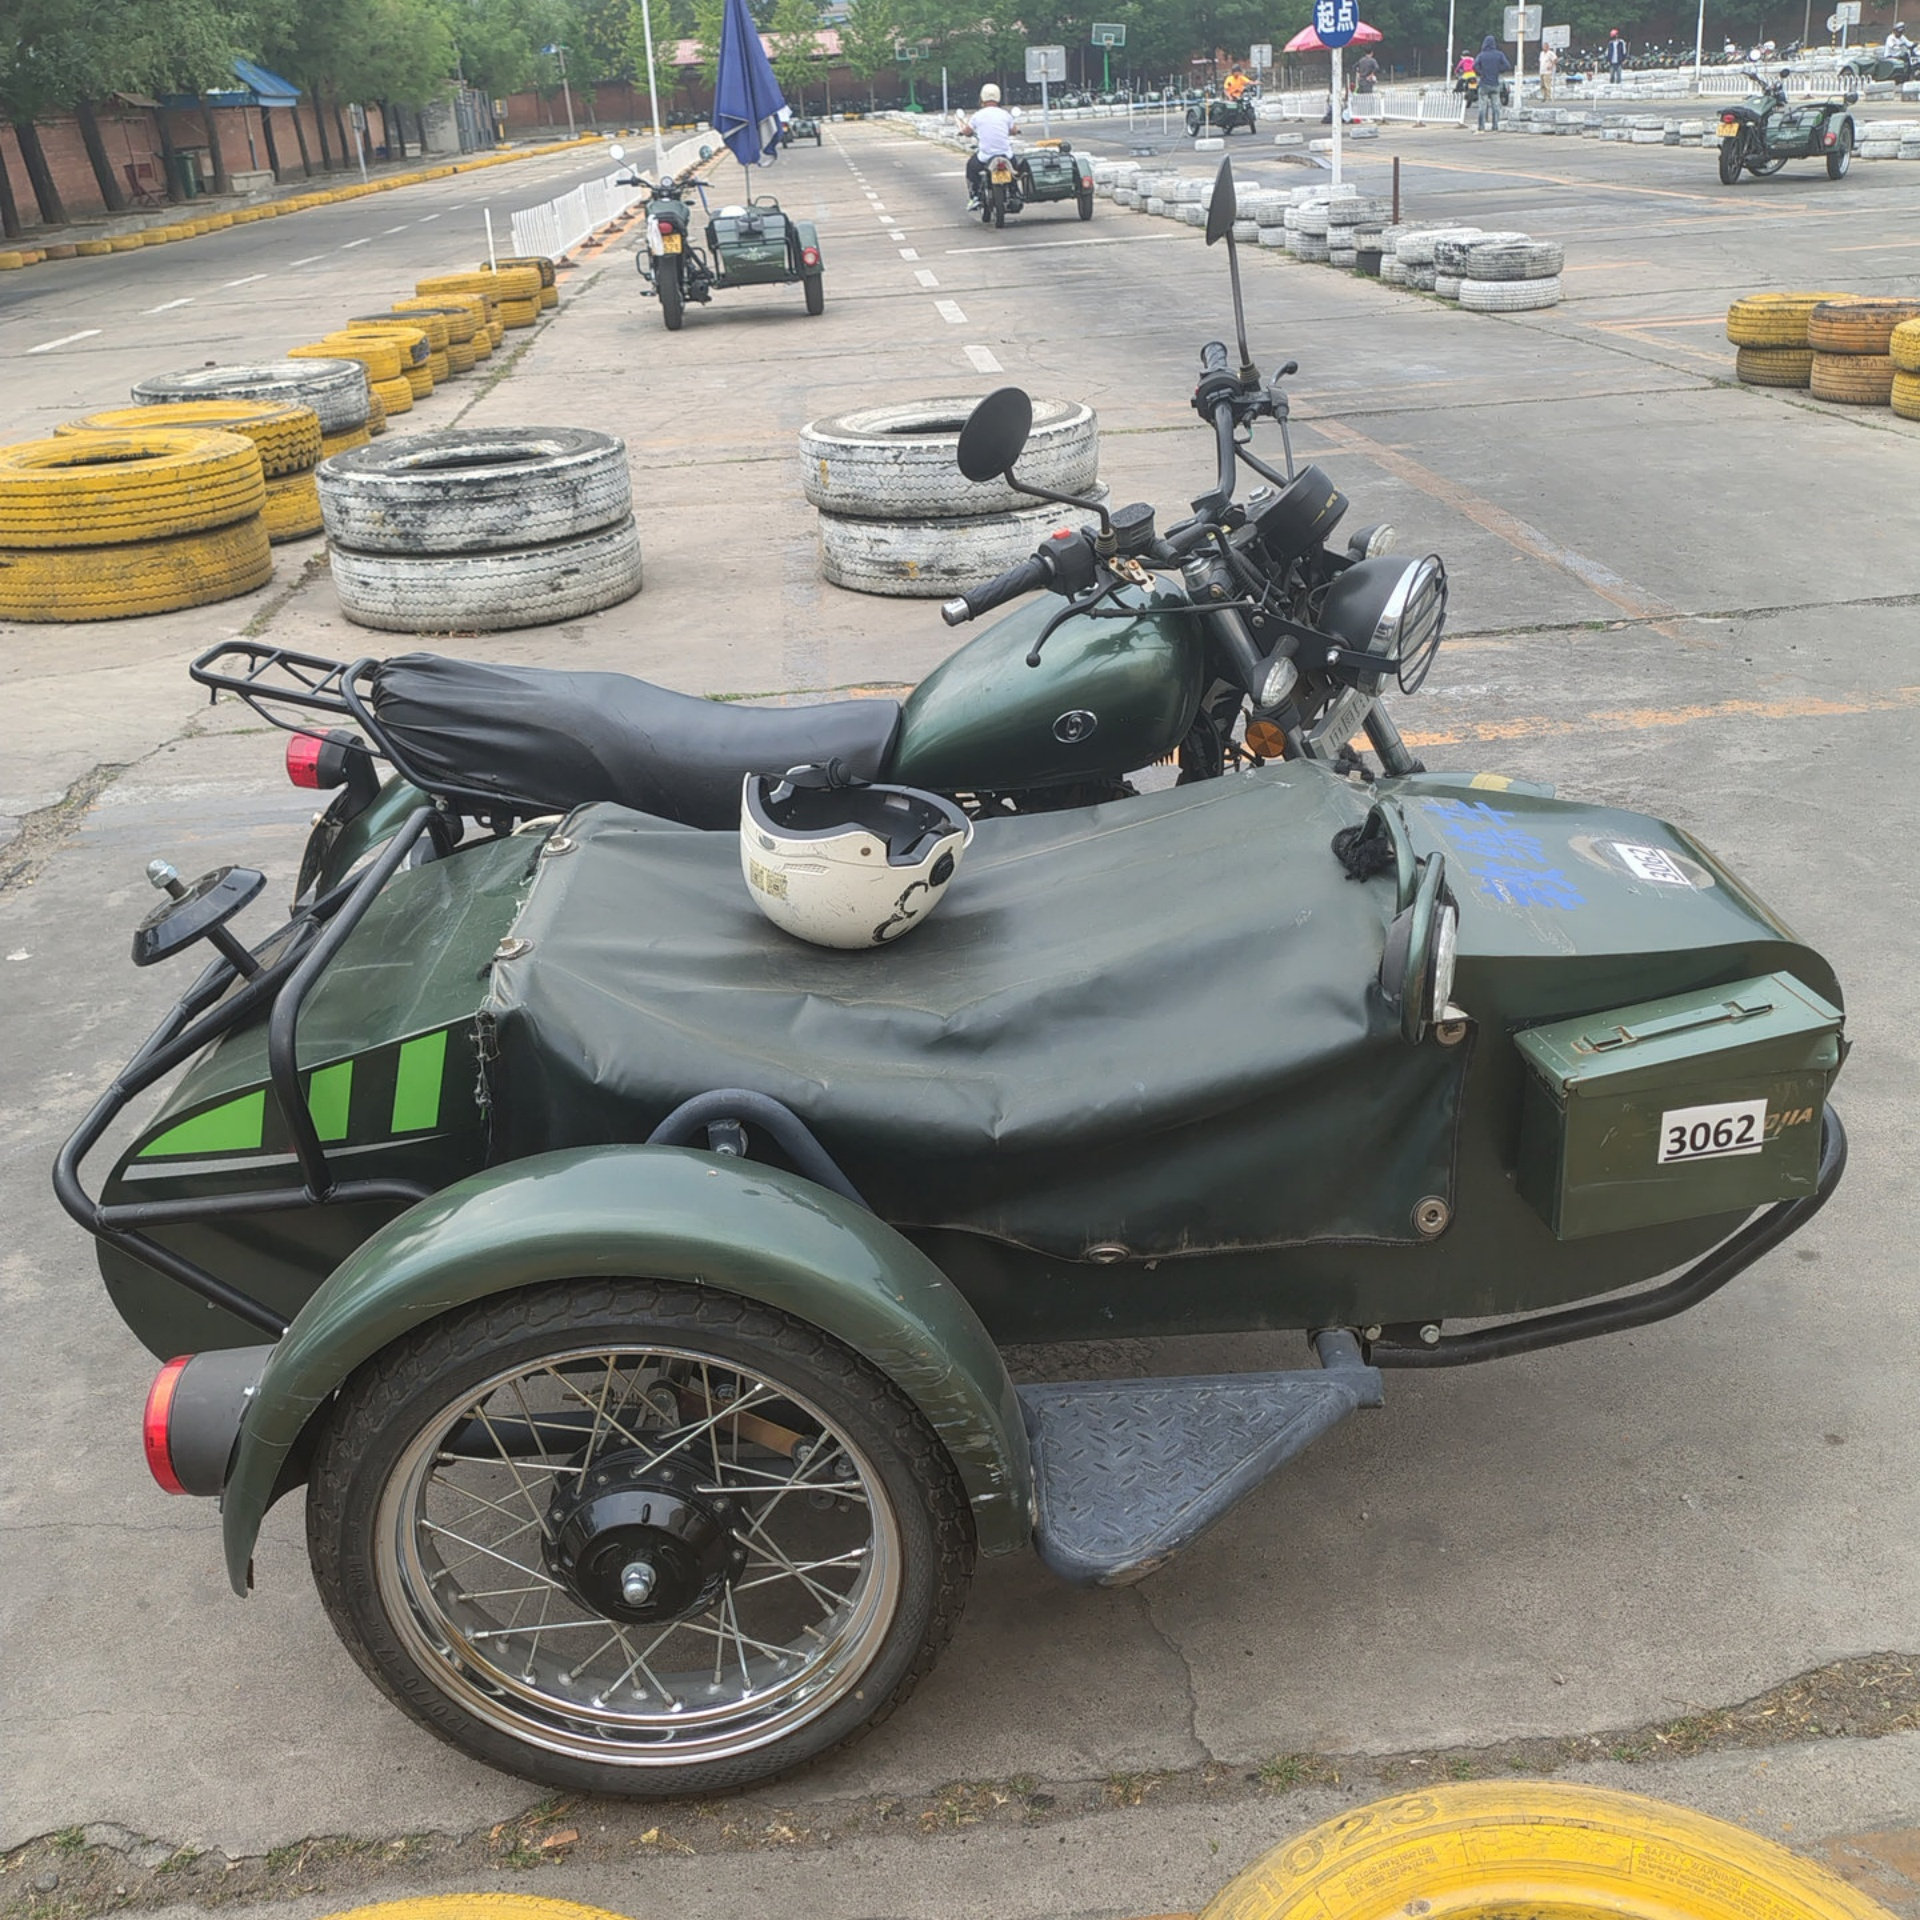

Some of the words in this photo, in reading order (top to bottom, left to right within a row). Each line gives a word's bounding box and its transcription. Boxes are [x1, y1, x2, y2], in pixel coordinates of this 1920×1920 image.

[1317, 0, 1355, 34] 起点
[1627, 848, 1680, 880] 3062
[1666, 1114, 1756, 1155] 3062
